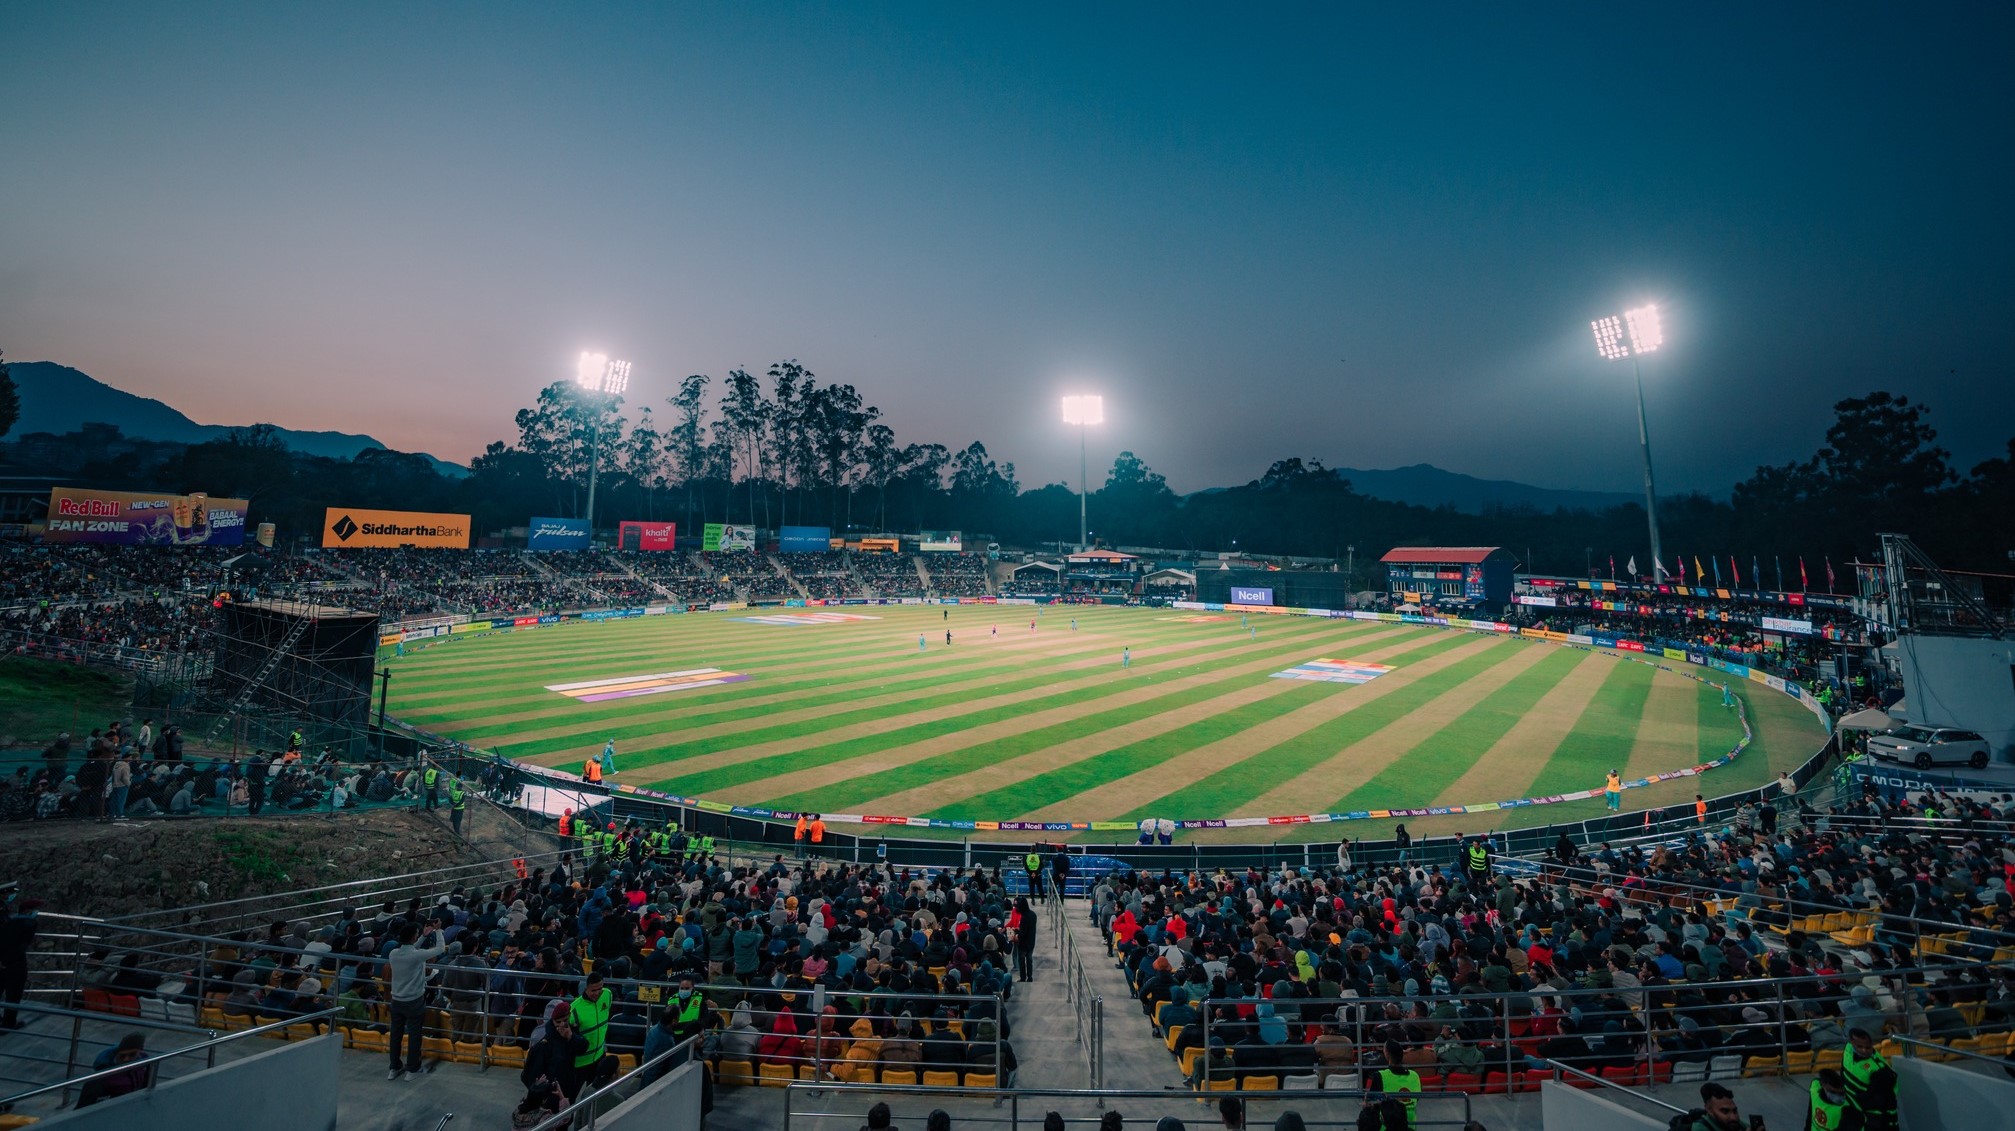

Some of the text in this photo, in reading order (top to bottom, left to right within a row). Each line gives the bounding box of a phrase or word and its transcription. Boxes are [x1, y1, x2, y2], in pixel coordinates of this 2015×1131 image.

[59, 498, 121, 517] Red Bull
[131, 500, 170, 510] NEW-GEN
[209, 511, 238, 520] BABAAL
[49, 520, 129, 533] FAN ZONE
[645, 528, 669, 537] khalti
[1238, 591, 1265, 602] Ncell
[1762, 617, 1791, 627] Shikhar
[1773, 622, 1812, 634] Insurance
[1690, 654, 1704, 665] Ncell
